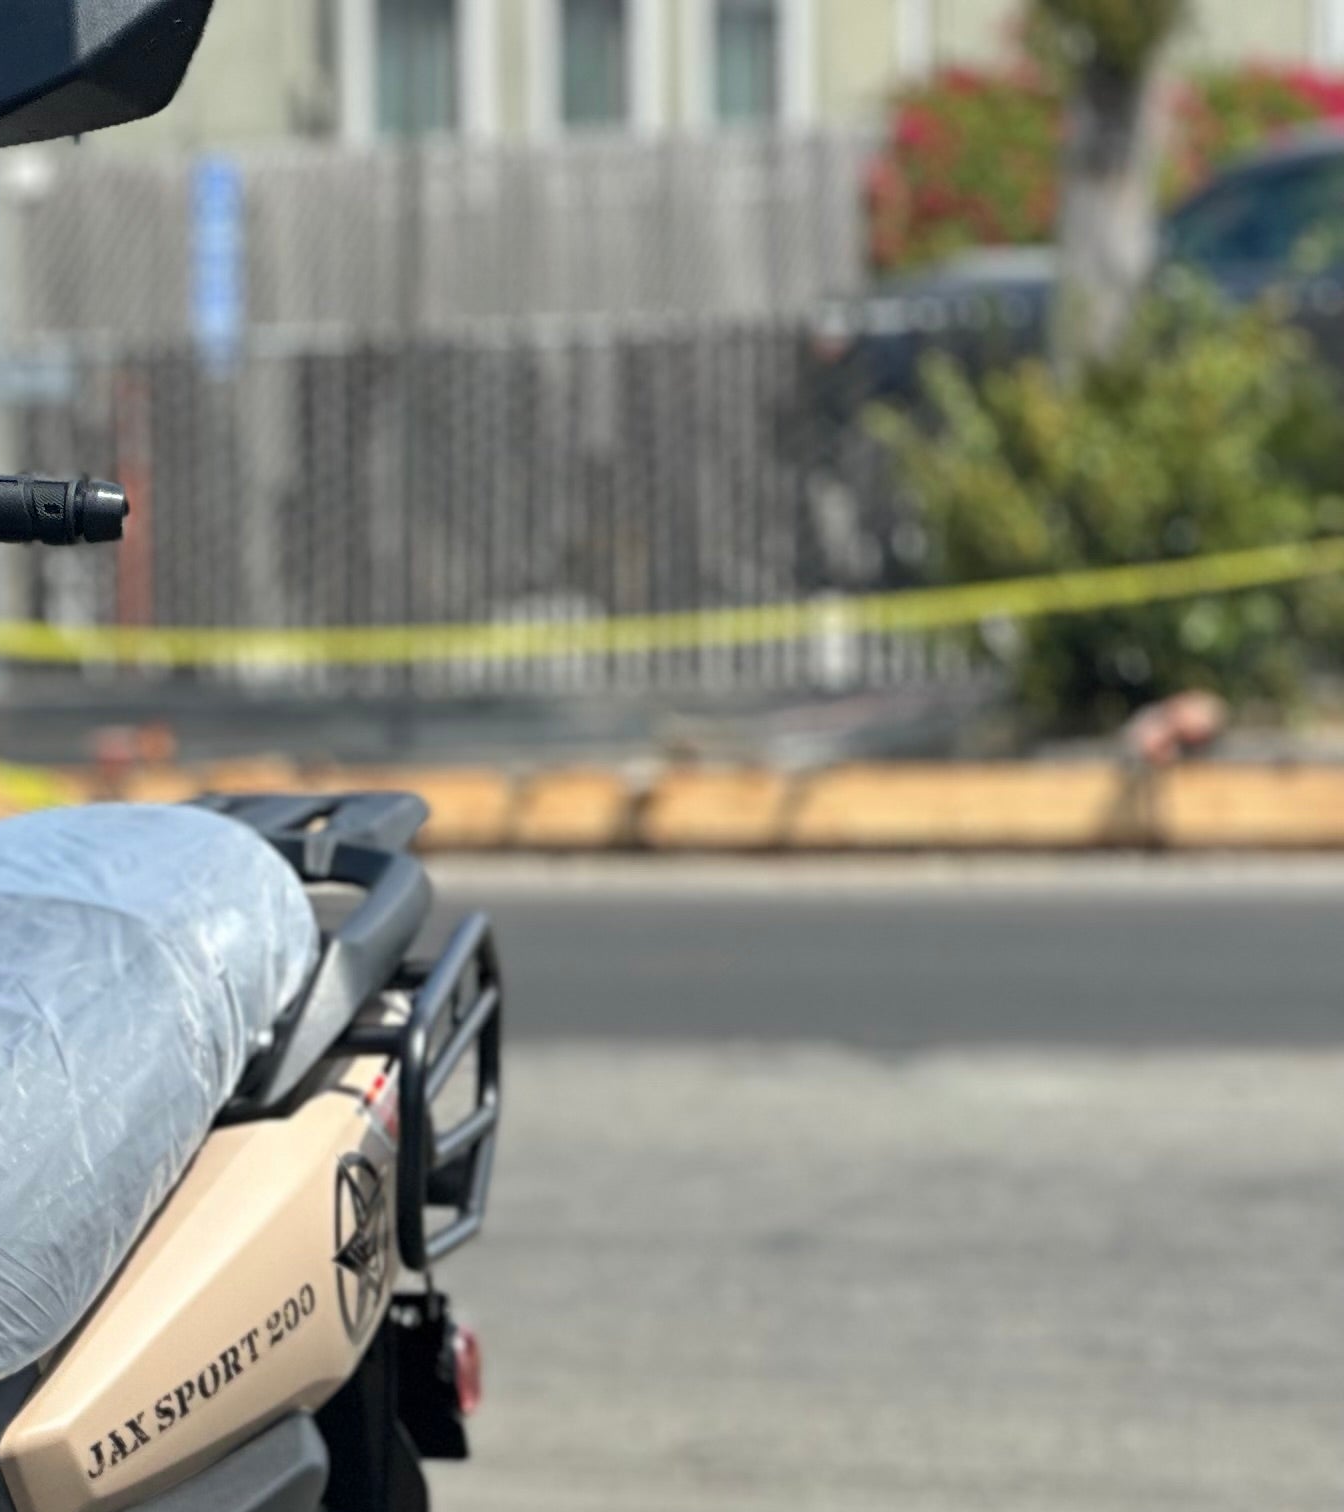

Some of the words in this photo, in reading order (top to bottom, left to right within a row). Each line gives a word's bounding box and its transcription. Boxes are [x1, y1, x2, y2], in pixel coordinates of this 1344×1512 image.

[88, 1411, 151, 1479] JAX
[155, 1328, 260, 1433] SPORT
[265, 1283, 316, 1348] 200
